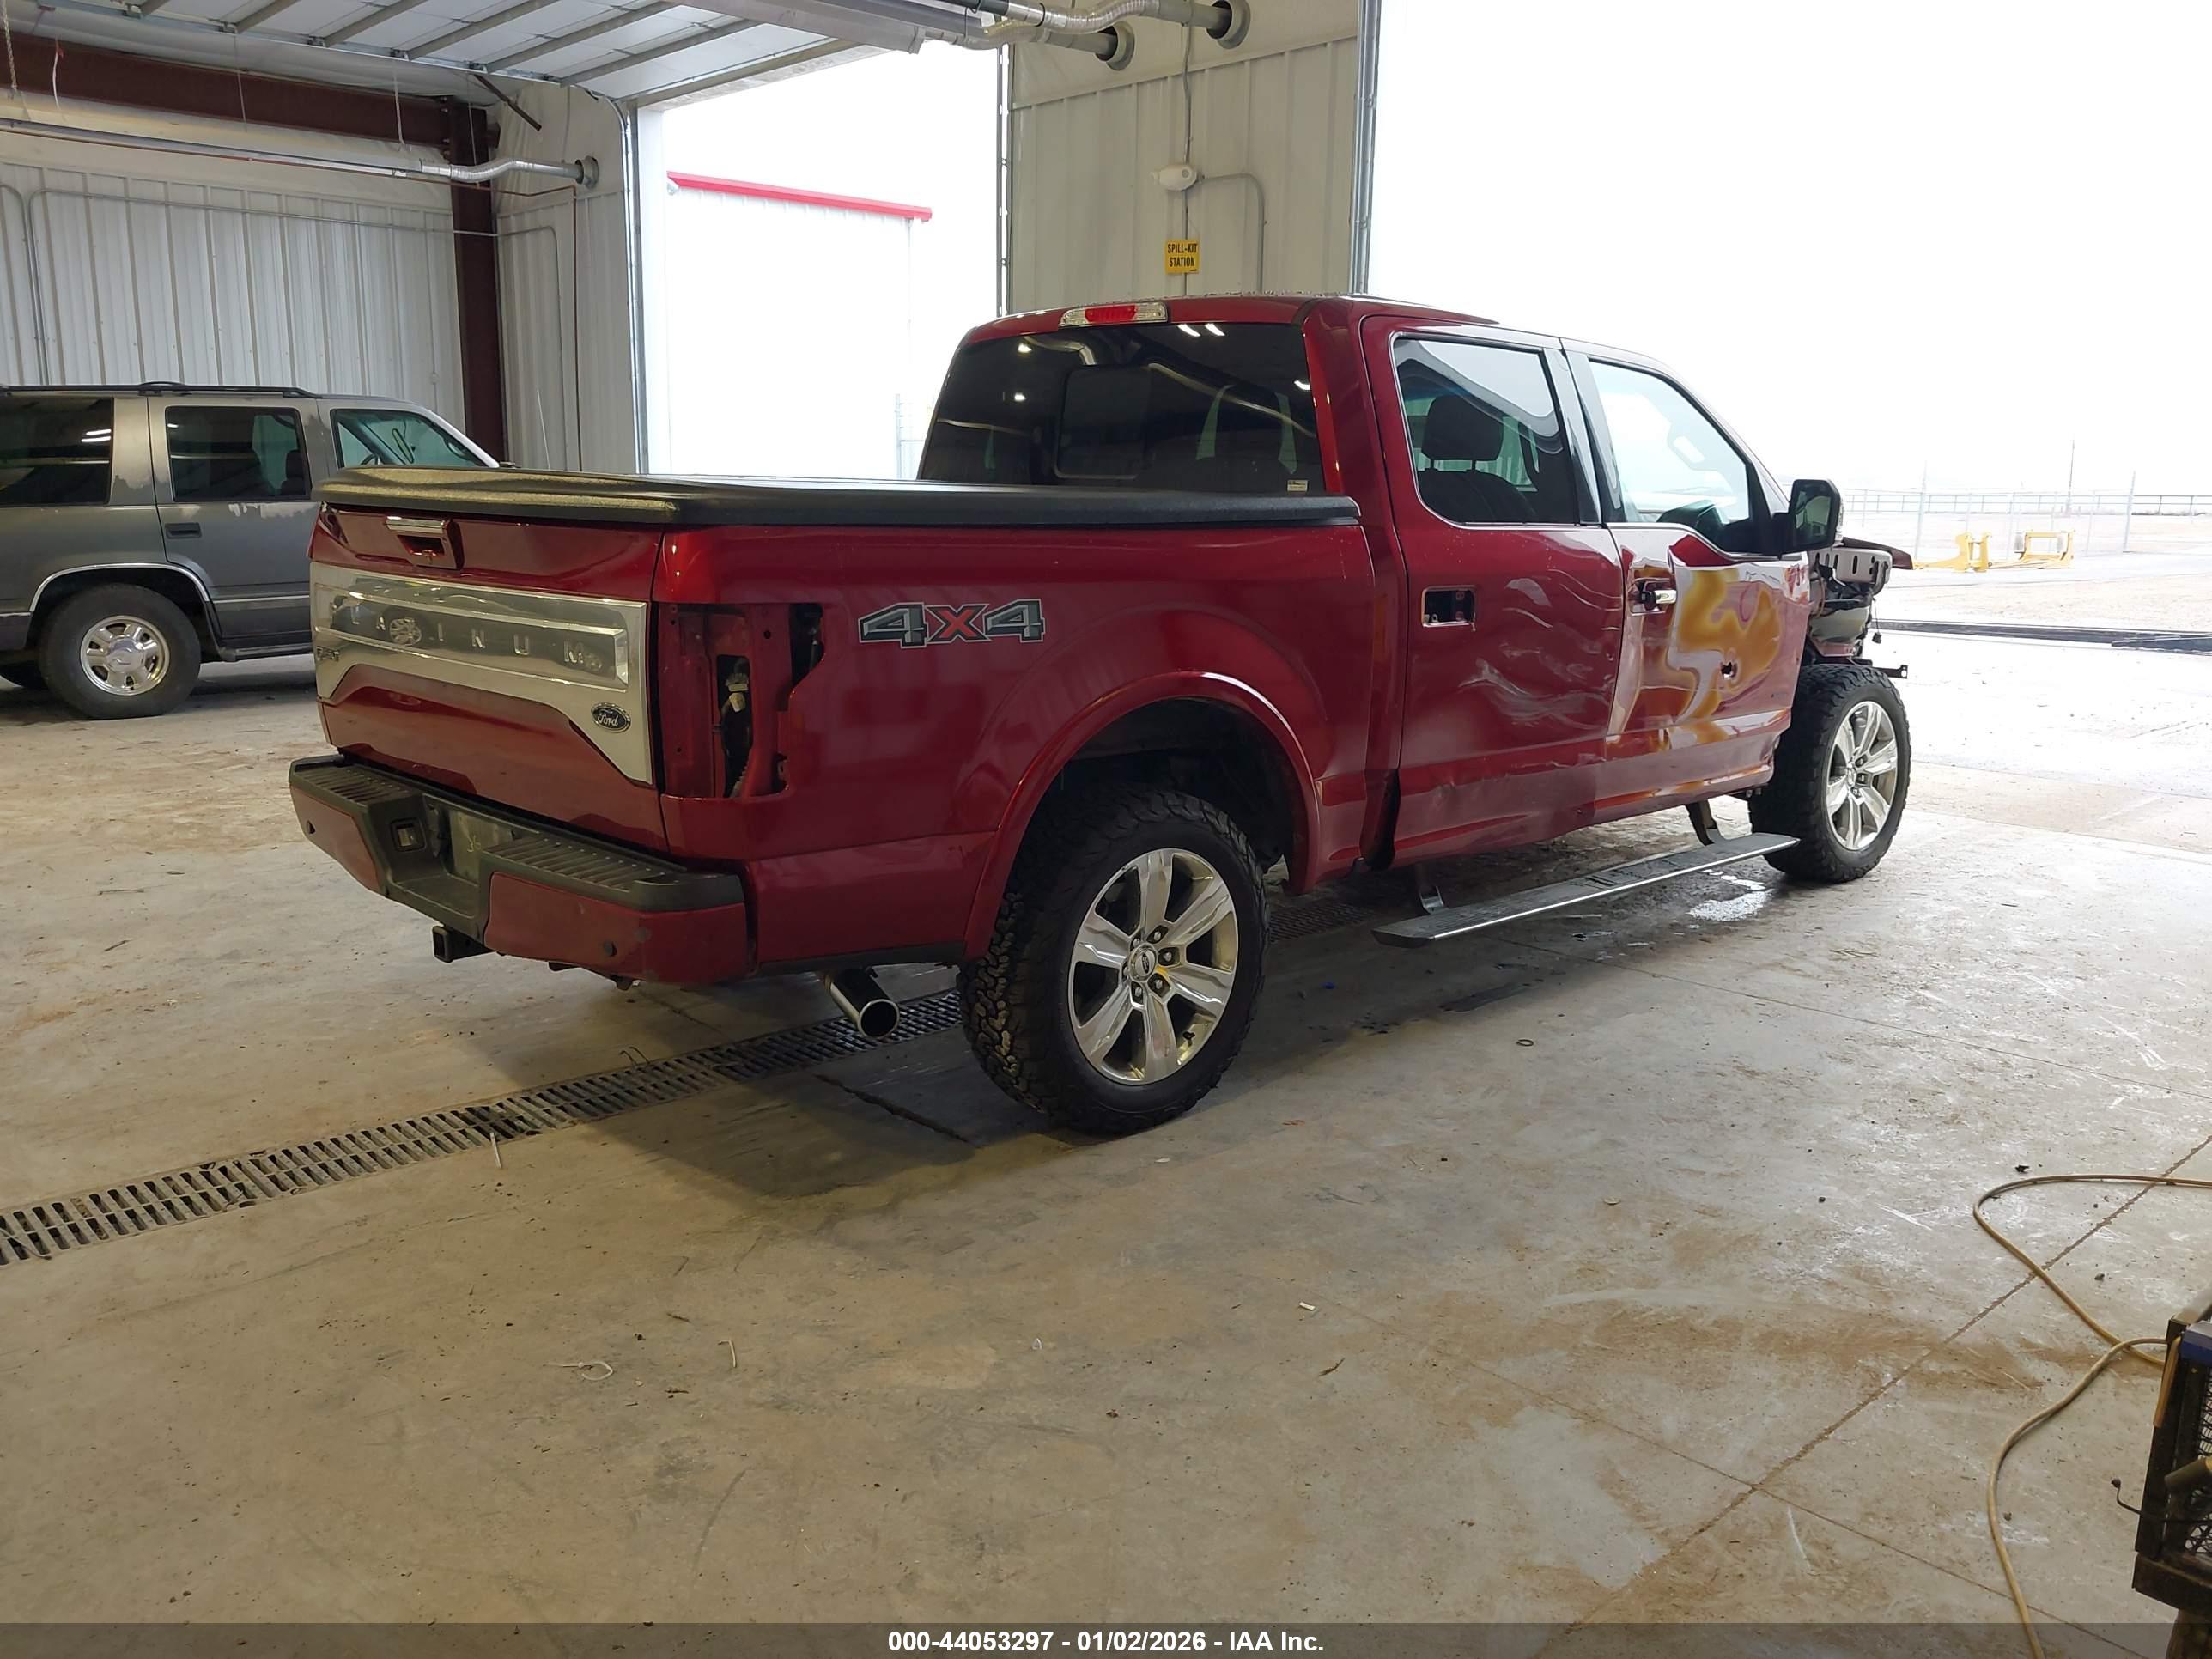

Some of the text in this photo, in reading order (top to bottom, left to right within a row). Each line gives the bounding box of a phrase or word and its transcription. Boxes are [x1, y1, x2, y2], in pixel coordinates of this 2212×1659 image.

[1167, 243, 1198, 253] SPILL-KIT
[1169, 257, 1195, 267] STATION
[329, 599, 585, 664] LAINUM
